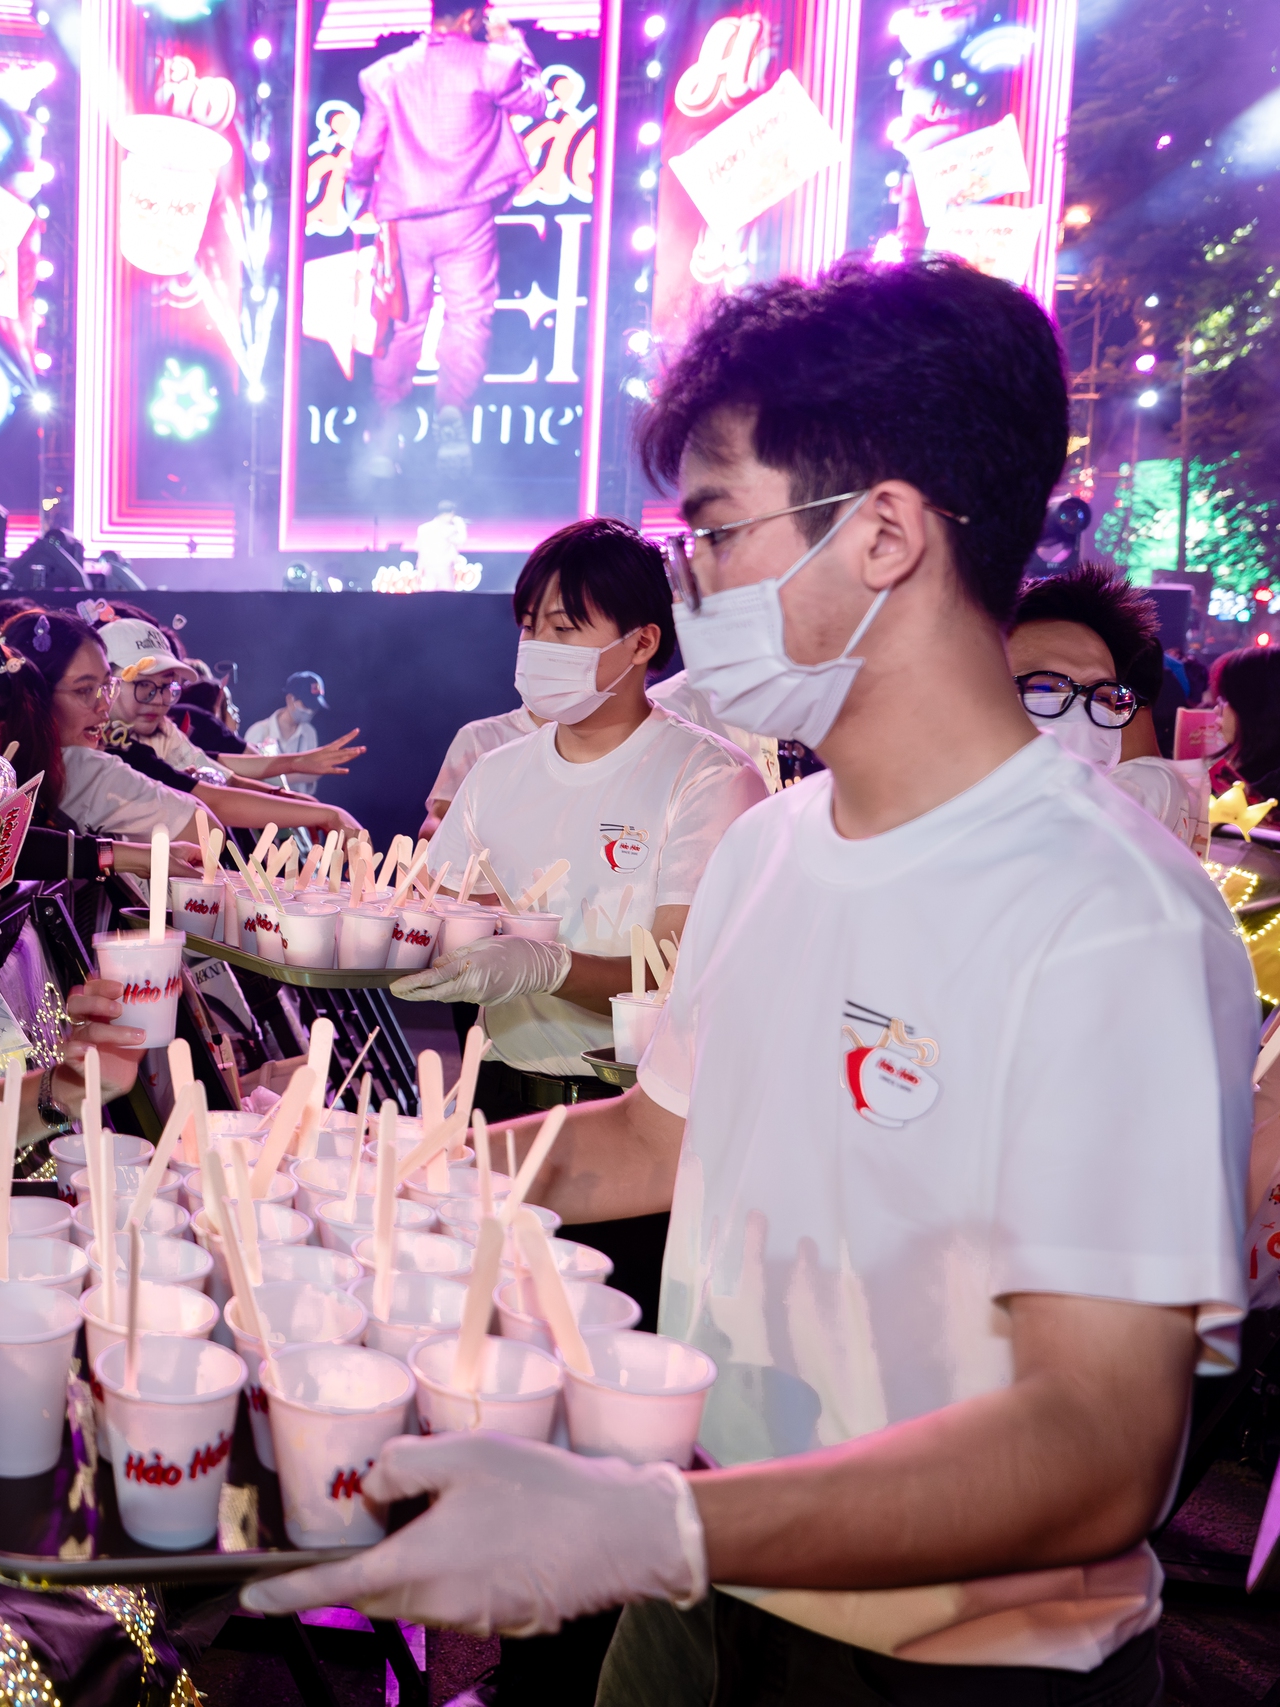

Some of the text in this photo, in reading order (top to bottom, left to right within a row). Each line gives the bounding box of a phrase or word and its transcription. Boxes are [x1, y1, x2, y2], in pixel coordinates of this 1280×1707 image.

[185, 898, 209, 915] Hảo
[405, 928, 432, 947] Hảo
[123, 979, 162, 1005] Hảo
[125, 1452, 183, 1486] Hảo
